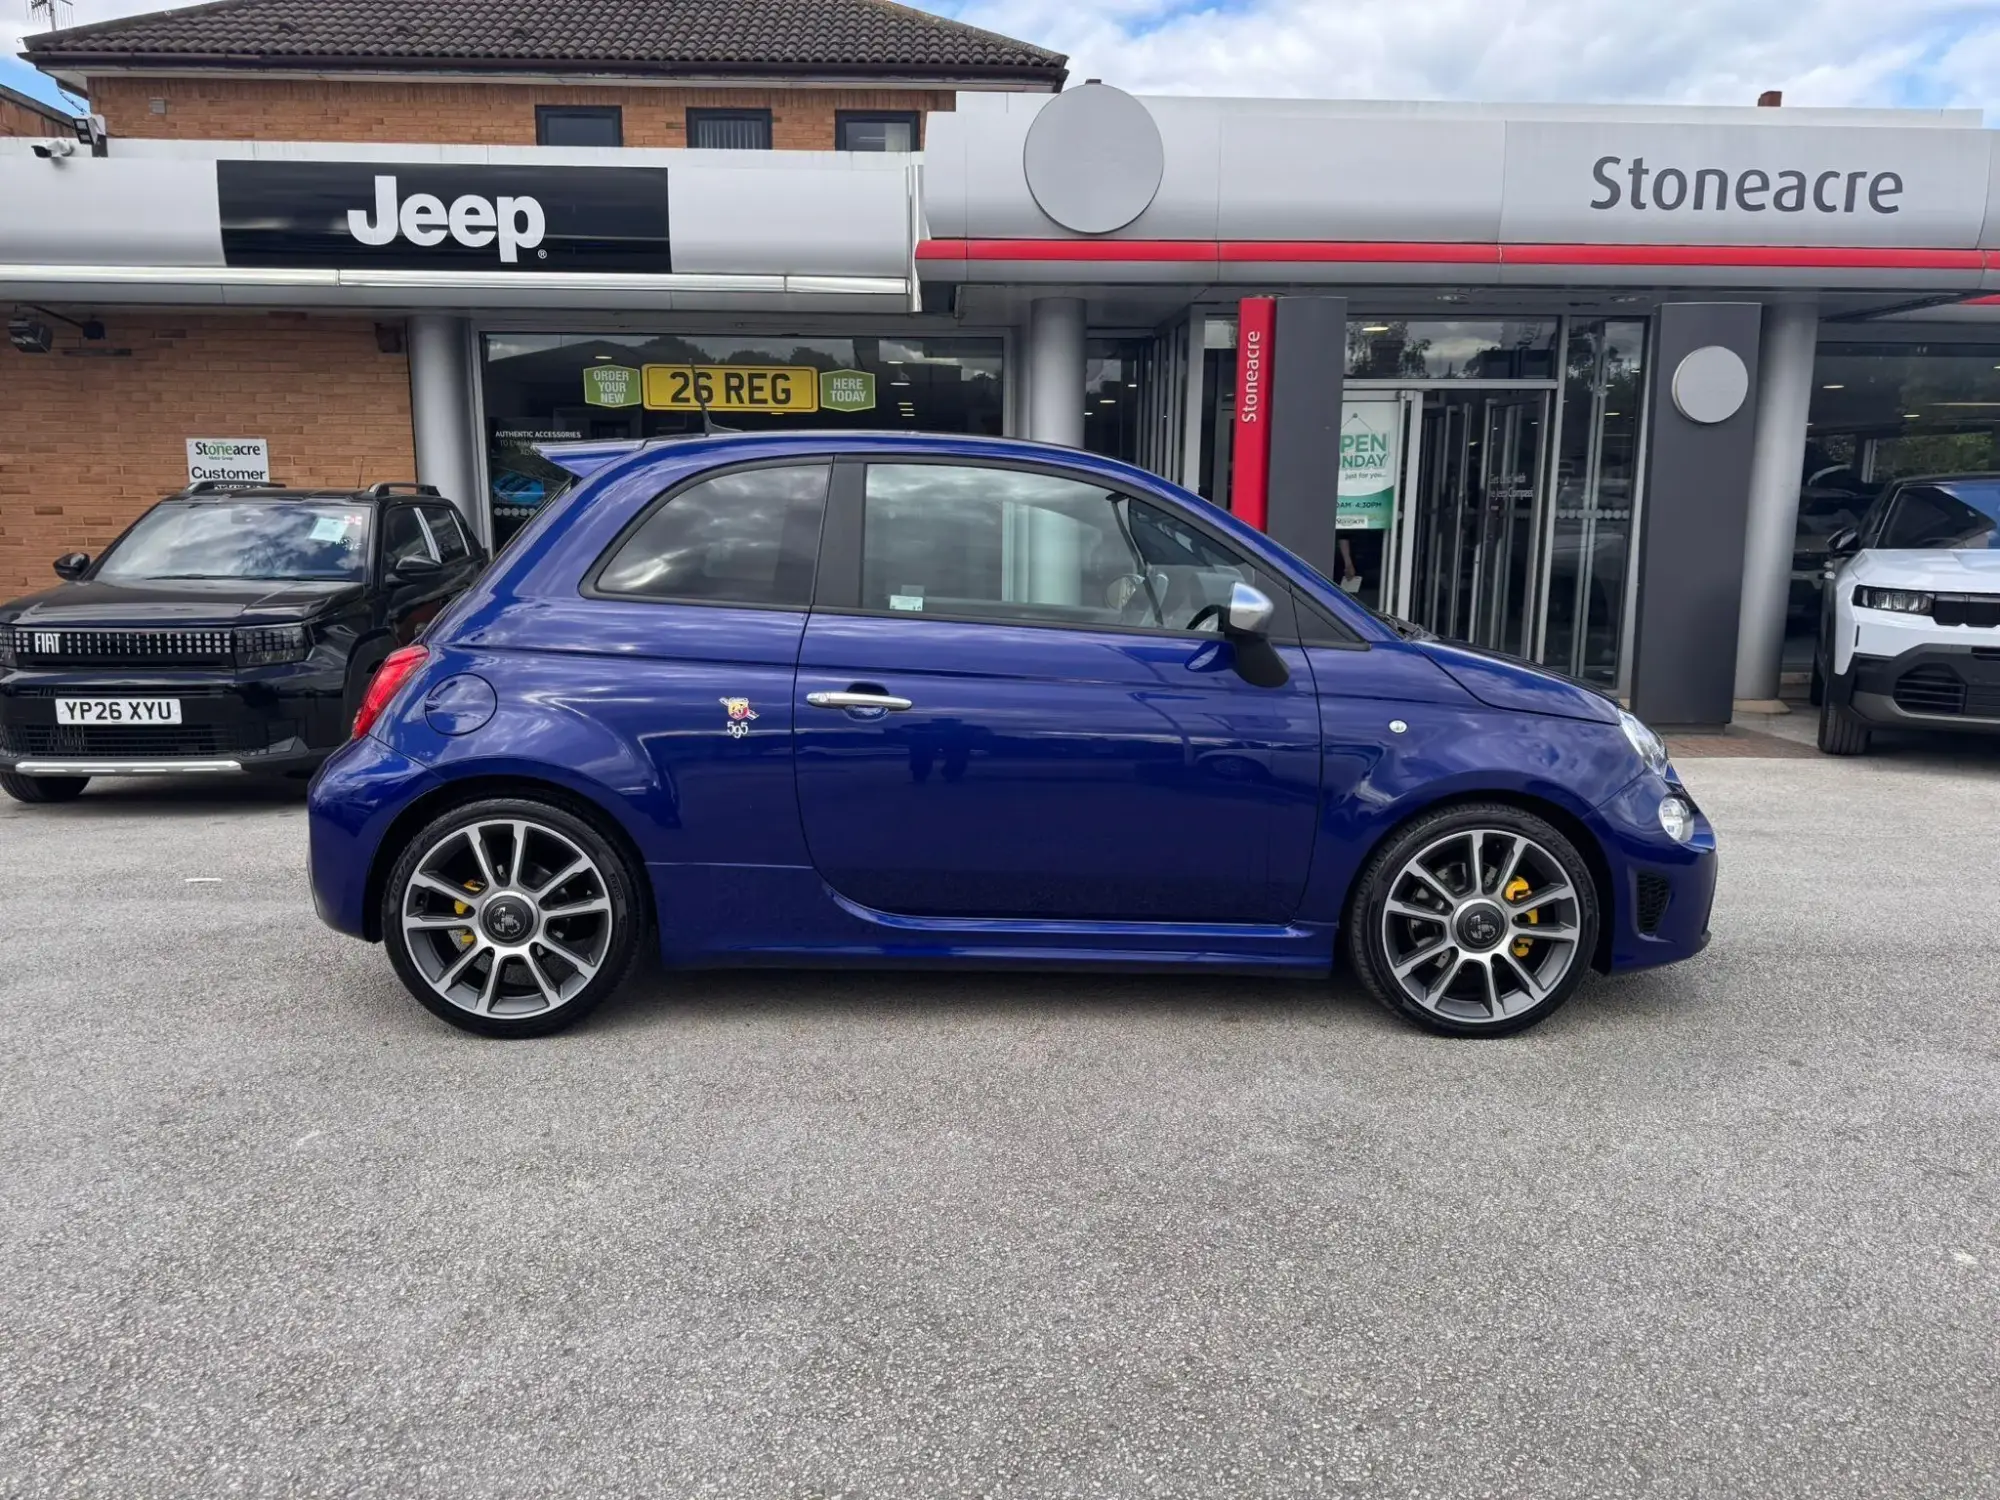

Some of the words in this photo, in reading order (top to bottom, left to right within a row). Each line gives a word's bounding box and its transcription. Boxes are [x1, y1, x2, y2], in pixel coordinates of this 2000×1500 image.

[1590, 156, 1903, 214] Stoneacre
[347, 175, 545, 262] Jeep
[593, 370, 629, 381] ORDER
[1242, 331, 1260, 422] Stoneacre
[598, 382, 626, 393] YOUR
[670, 371, 713, 404] 26
[724, 372, 791, 405] REG
[833, 378, 863, 390] HERE
[600, 393, 624, 404] NEW
[830, 390, 866, 402] TODAY
[195, 441, 261, 456] Stoneacre
[1340, 433, 1387, 453] PEN
[1341, 454, 1387, 468] NDAY
[191, 466, 266, 480] Customer
[34, 633, 60, 653] FIAT
[65, 702, 122, 720] YP26
[128, 702, 172, 720] XYU
[727, 721, 749, 739] 595
